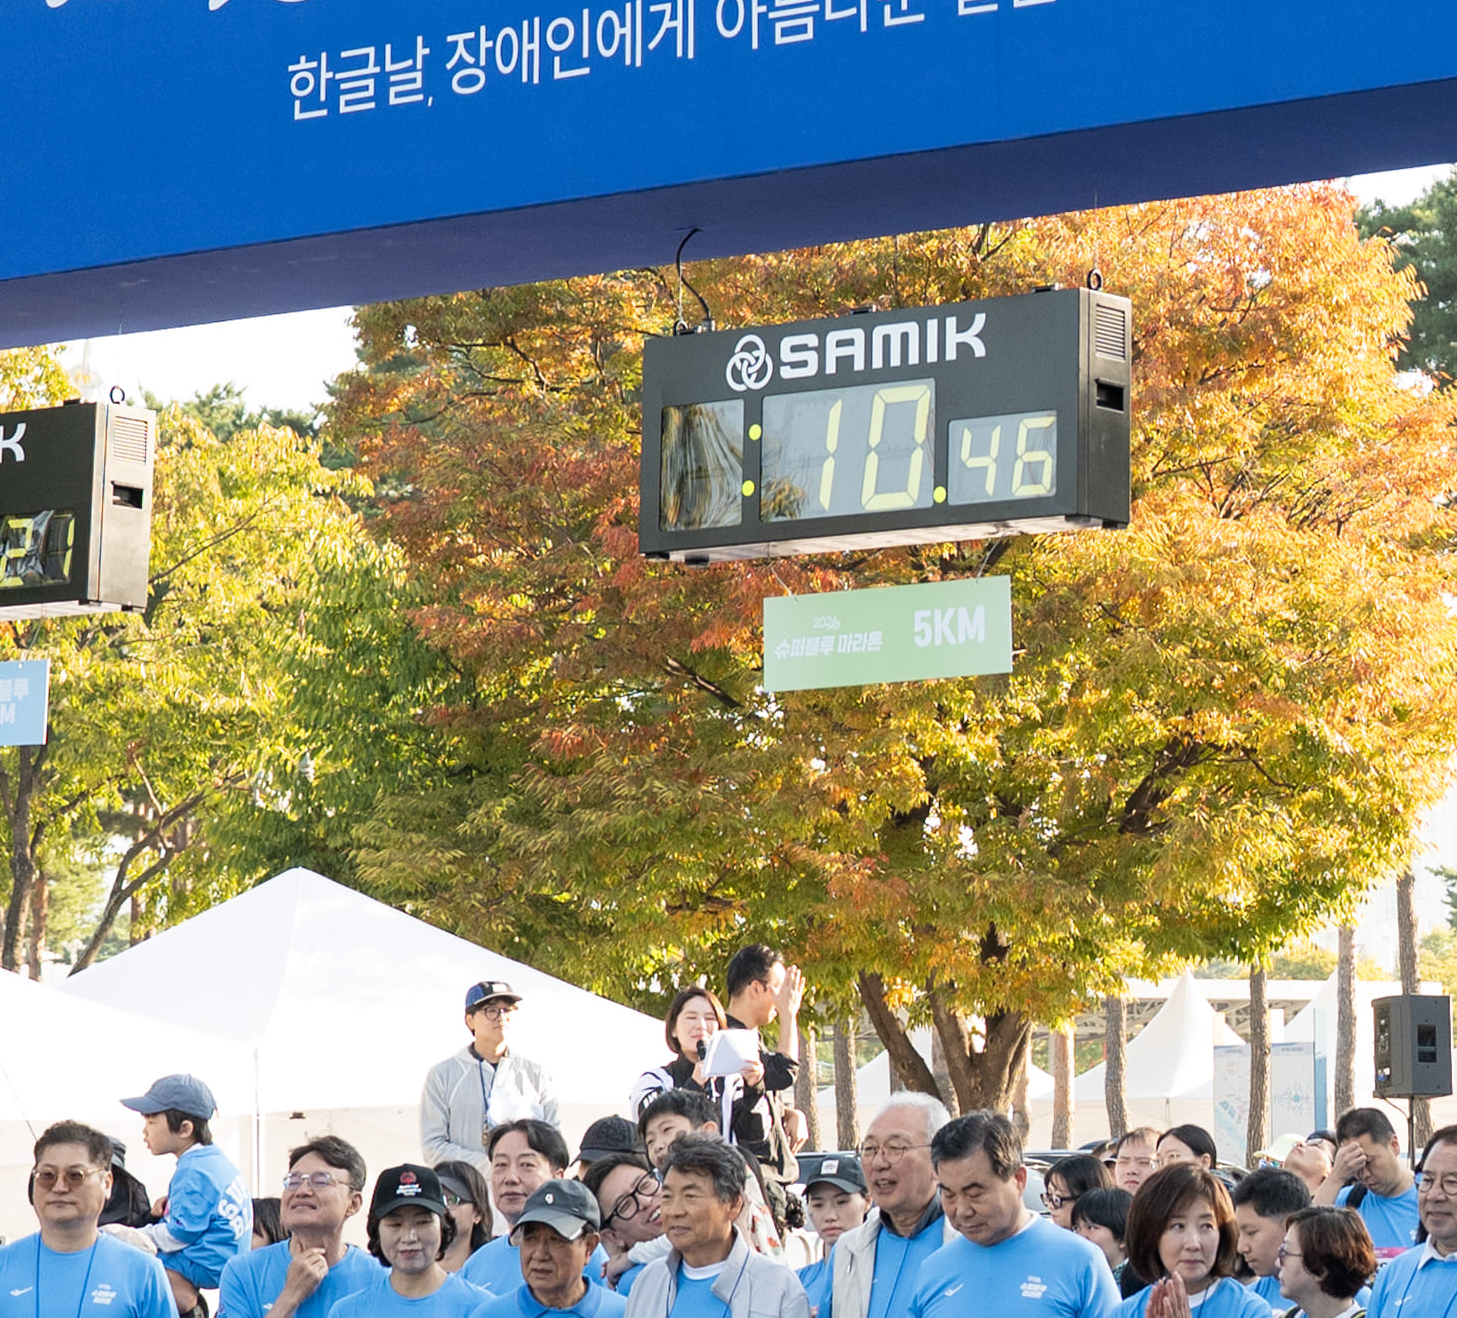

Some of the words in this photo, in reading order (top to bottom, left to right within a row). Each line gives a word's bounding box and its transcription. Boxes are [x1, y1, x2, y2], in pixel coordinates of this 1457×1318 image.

[288, 47, 436, 122] 한글날,
[779, 313, 987, 380] SAMIK
[774, 635, 835, 659] 슈퍼블루
[837, 630, 883, 654] 마라톤
[913, 605, 985, 647] 5KM
